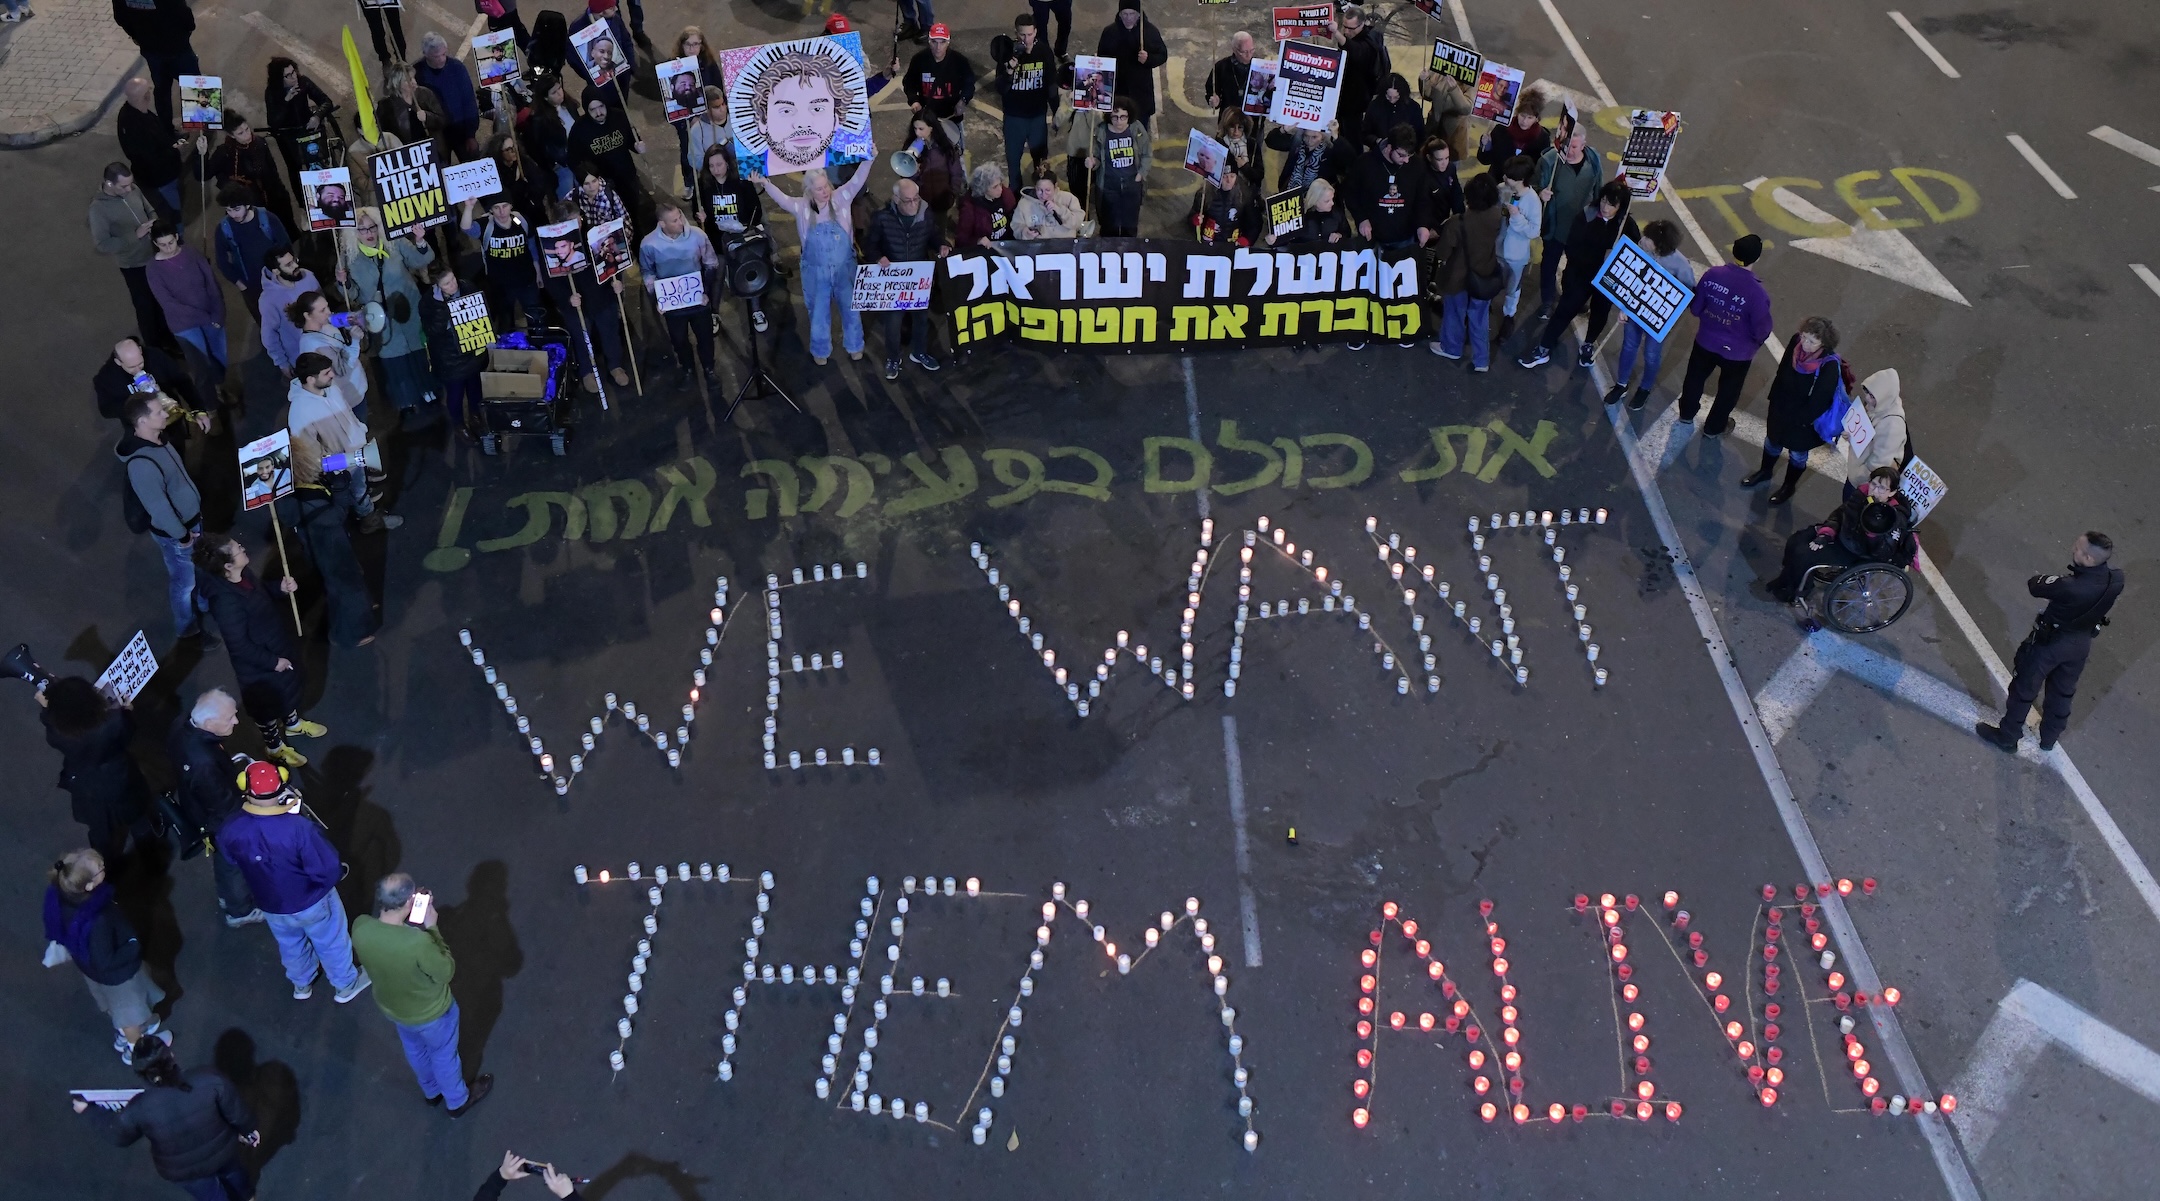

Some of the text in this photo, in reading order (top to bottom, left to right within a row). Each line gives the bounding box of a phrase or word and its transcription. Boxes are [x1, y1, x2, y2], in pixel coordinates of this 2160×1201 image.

[1299, 7, 1329, 18] לא נשאיר
[1283, 60, 1309, 75] עכשיו!
[1289, 50, 1322, 66] למלחמה
[1324, 58, 1332, 68] די
[1435, 41, 1478, 71] בלעדיהם
[1310, 66, 1335, 80] עסקה
[1283, 107, 1320, 122] עכשיו
[1284, 96, 1322, 113] את כולם
[846, 143, 866, 156] אלון
[1109, 136, 1132, 149] למה הם
[1110, 147, 1134, 159] עדיין
[375, 141, 432, 179] ALL OF
[376, 162, 440, 203] THEM
[382, 187, 446, 229] NOW!
[1270, 195, 1300, 216] GET MY
[1272, 205, 1302, 226] PEOPLE
[1273, 216, 1304, 237] HOME!
[1618, 246, 1647, 275] את
[854, 278, 882, 291] Please
[884, 280, 919, 292] pressure
[947, 251, 1167, 301] ישראל
[1183, 247, 1419, 300] ממשלת
[660, 276, 701, 296] כולנו
[853, 290, 915, 301] to release ALL
[1609, 259, 1674, 320] המלחמה
[1642, 267, 1684, 306] עצרו
[447, 292, 485, 313] תוציאו
[657, 290, 702, 312] חטופים
[1614, 284, 1665, 330] למען כולנו
[1732, 294, 1746, 306] לא
[450, 303, 489, 326] מעזה
[954, 296, 1421, 346] קוברת את חטופיה!
[454, 316, 493, 340] וצאו
[459, 330, 497, 354] מעזה
[1903, 468, 1931, 497] BRING
[422, 418, 1558, 573] את כולם בפעימה אחת!
[1907, 484, 1931, 511] THEM
[107, 660, 123, 679] Any
[122, 647, 134, 662] day
[122, 659, 135, 675] way
[135, 642, 148, 660] now
[458, 507, 1608, 796] WE WANT
[124, 663, 141, 684] shall
[140, 655, 150, 667] be
[573, 861, 1958, 1152] THEM ALIVE
